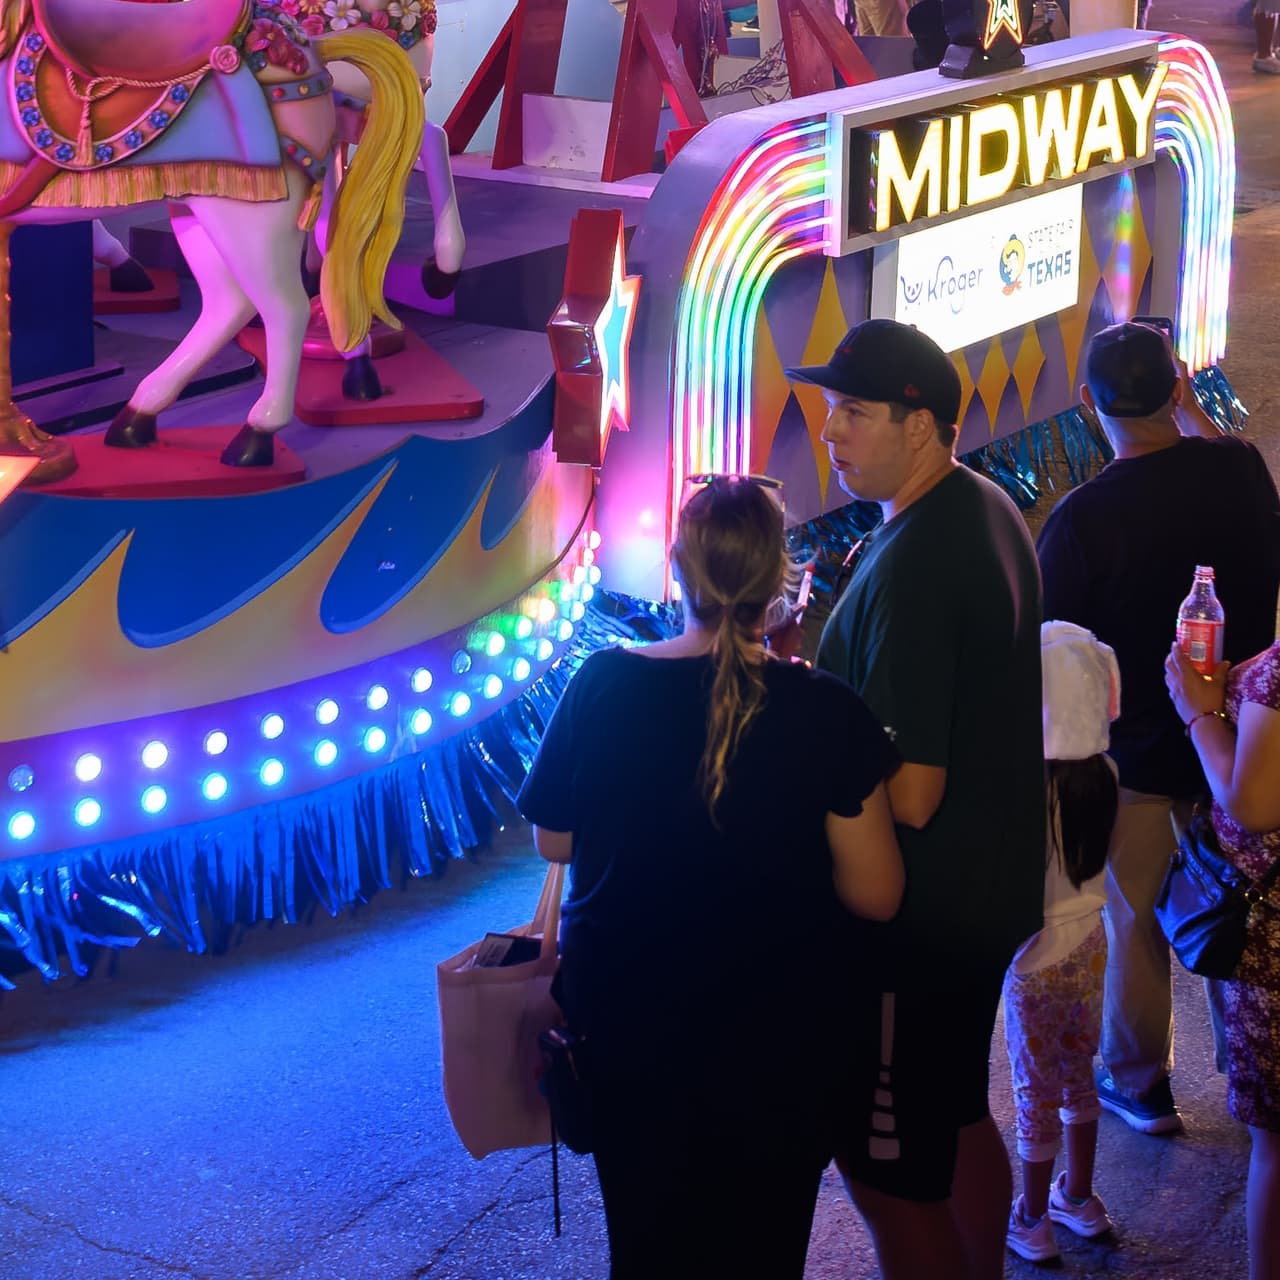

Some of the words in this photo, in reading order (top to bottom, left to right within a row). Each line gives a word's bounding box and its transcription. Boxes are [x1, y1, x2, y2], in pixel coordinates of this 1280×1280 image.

[875, 63, 1170, 232] MIDWAY
[927, 255, 984, 315] Kroger
[1027, 249, 1072, 288] TEXAS
